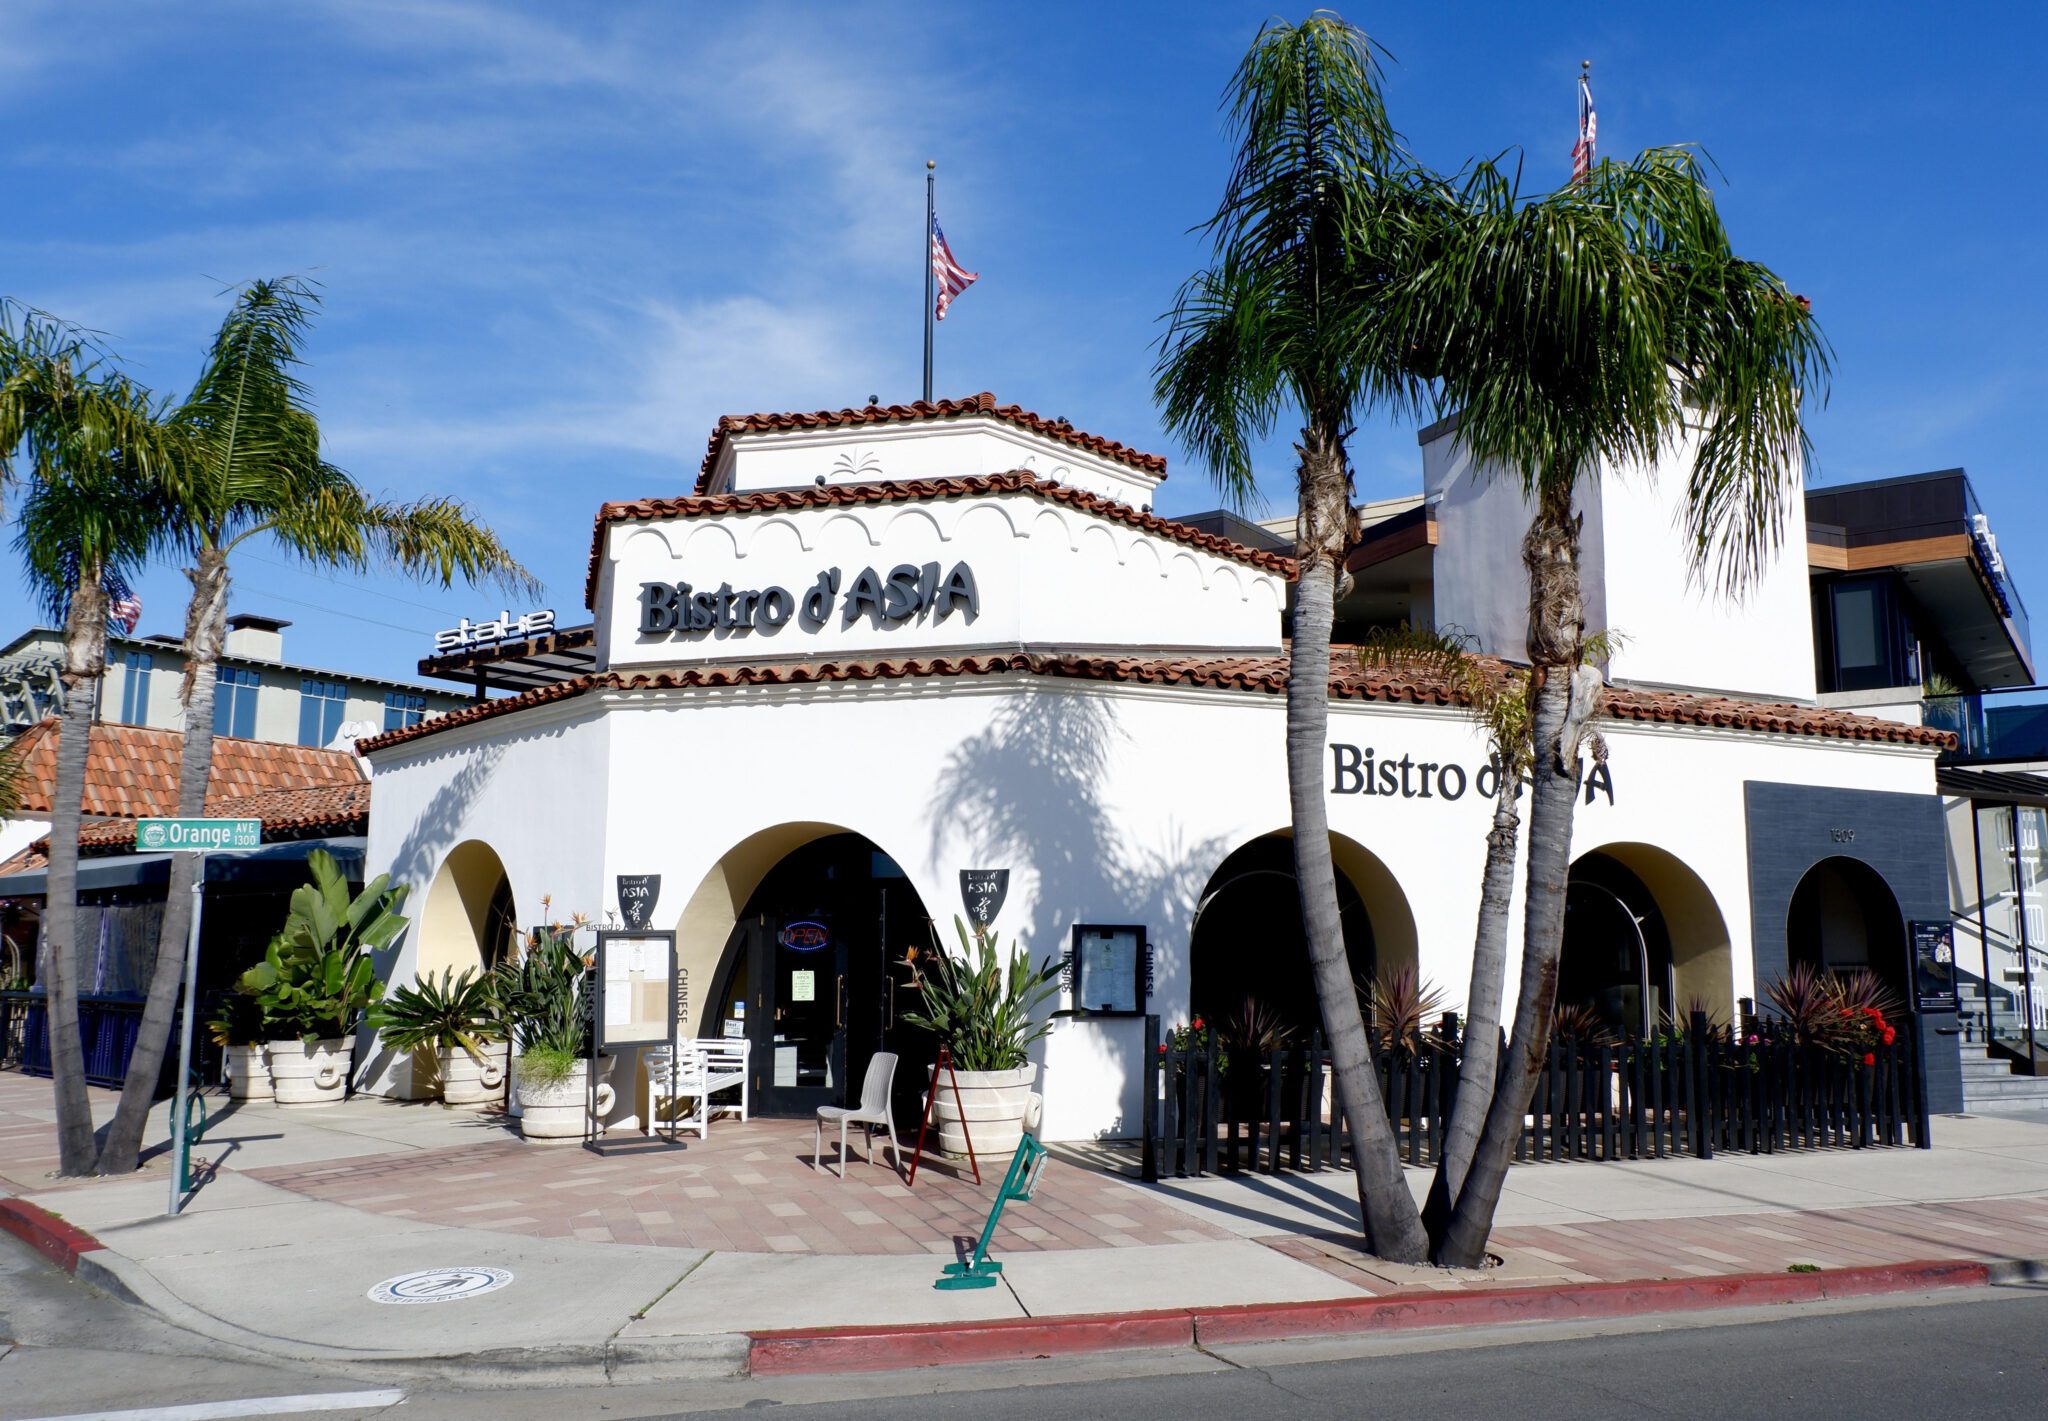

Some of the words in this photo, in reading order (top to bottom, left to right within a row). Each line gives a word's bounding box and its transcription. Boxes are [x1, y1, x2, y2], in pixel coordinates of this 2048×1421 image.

[638, 581, 795, 635] Bistro
[434, 609, 556, 651] stake
[1329, 743, 1467, 801] Bistro
[169, 823, 231, 849] Orange
[236, 823, 254, 833] AVE
[234, 835, 256, 846] 1300
[622, 886, 650, 898] ASIA
[783, 928, 830, 944] OPEN
[1144, 943, 1154, 998] CHINESE
[677, 968, 688, 1024] CHINESE
